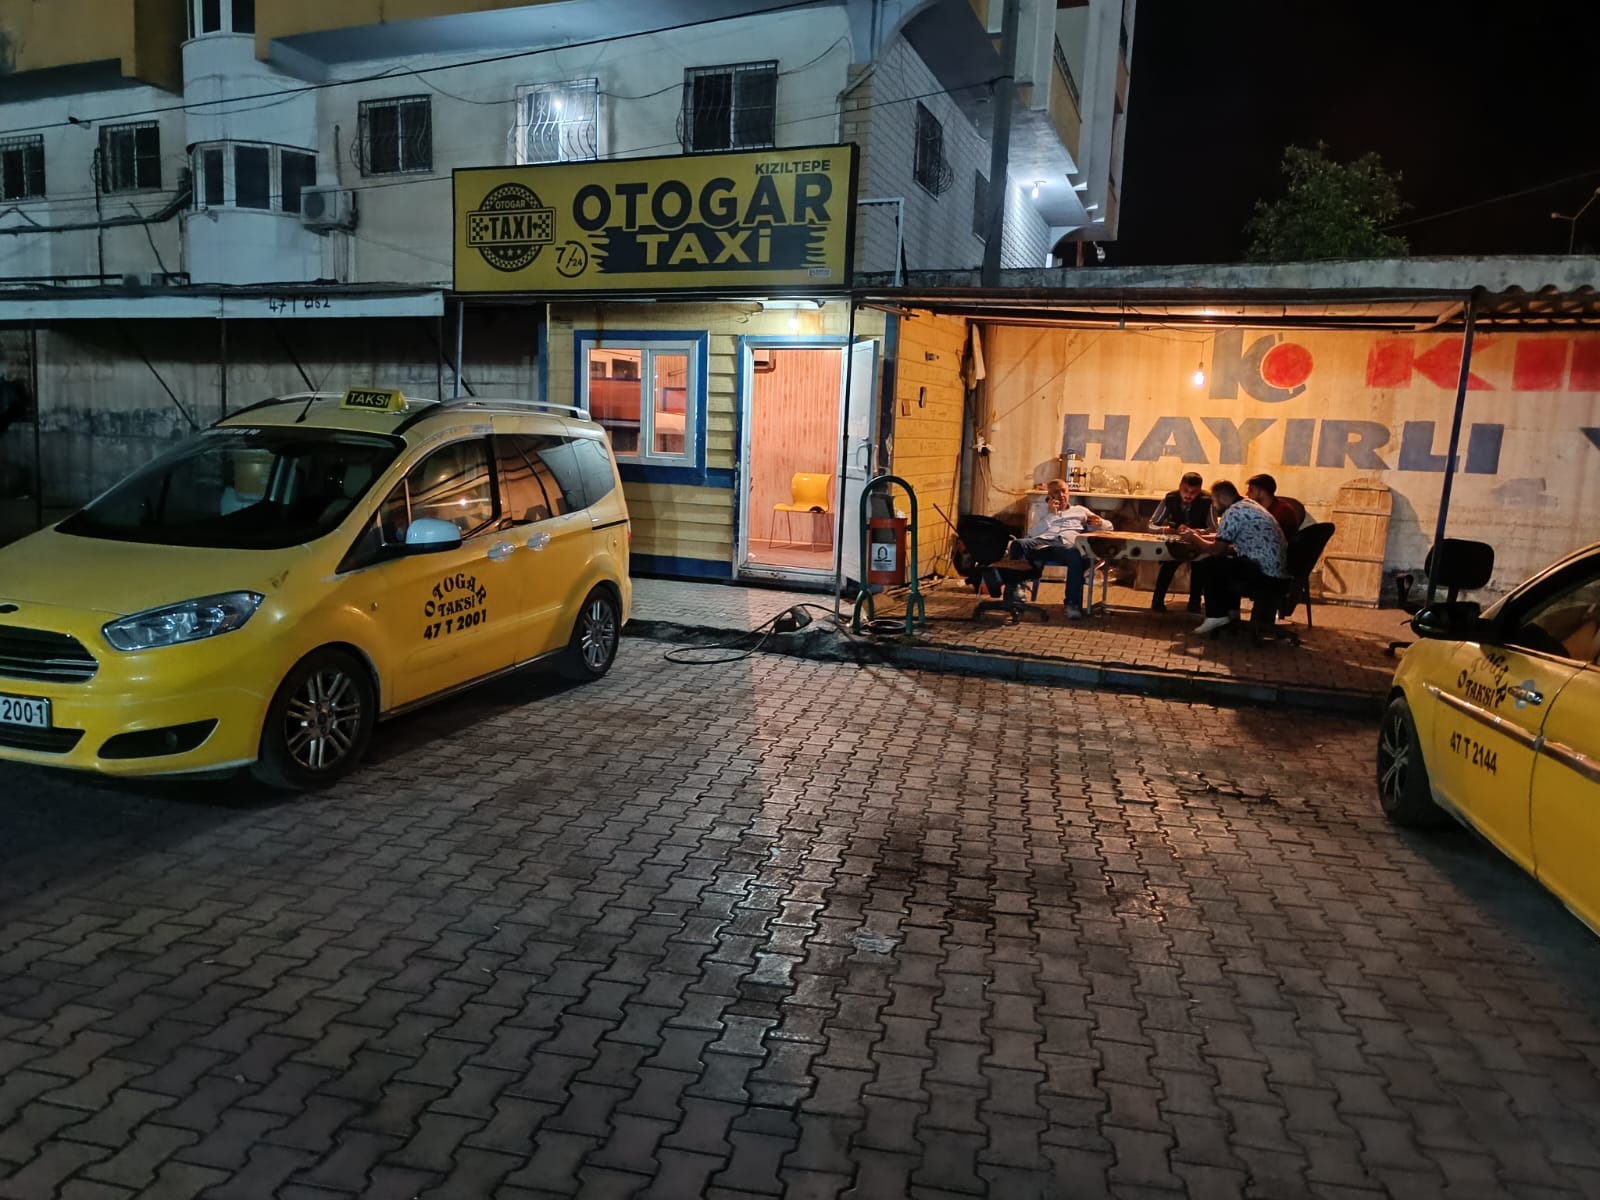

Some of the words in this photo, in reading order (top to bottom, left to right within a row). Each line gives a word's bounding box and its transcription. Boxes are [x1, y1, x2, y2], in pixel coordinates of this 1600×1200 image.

[755, 159, 831, 175] KIZILTEPE
[495, 199, 526, 209] OTOGAR
[573, 172, 833, 231] OTOGAR
[489, 215, 533, 240] TAXI
[1062, 413, 1504, 475] HAYIRLI
[423, 622, 442, 640] 47
[445, 618, 453, 634] T
[456, 608, 487, 631] 2001
[2, 699, 44, 725] 2001
[1450, 731, 1462, 753] 47
[1464, 737, 1471, 758] T
[1473, 742, 1498, 776] 2144
